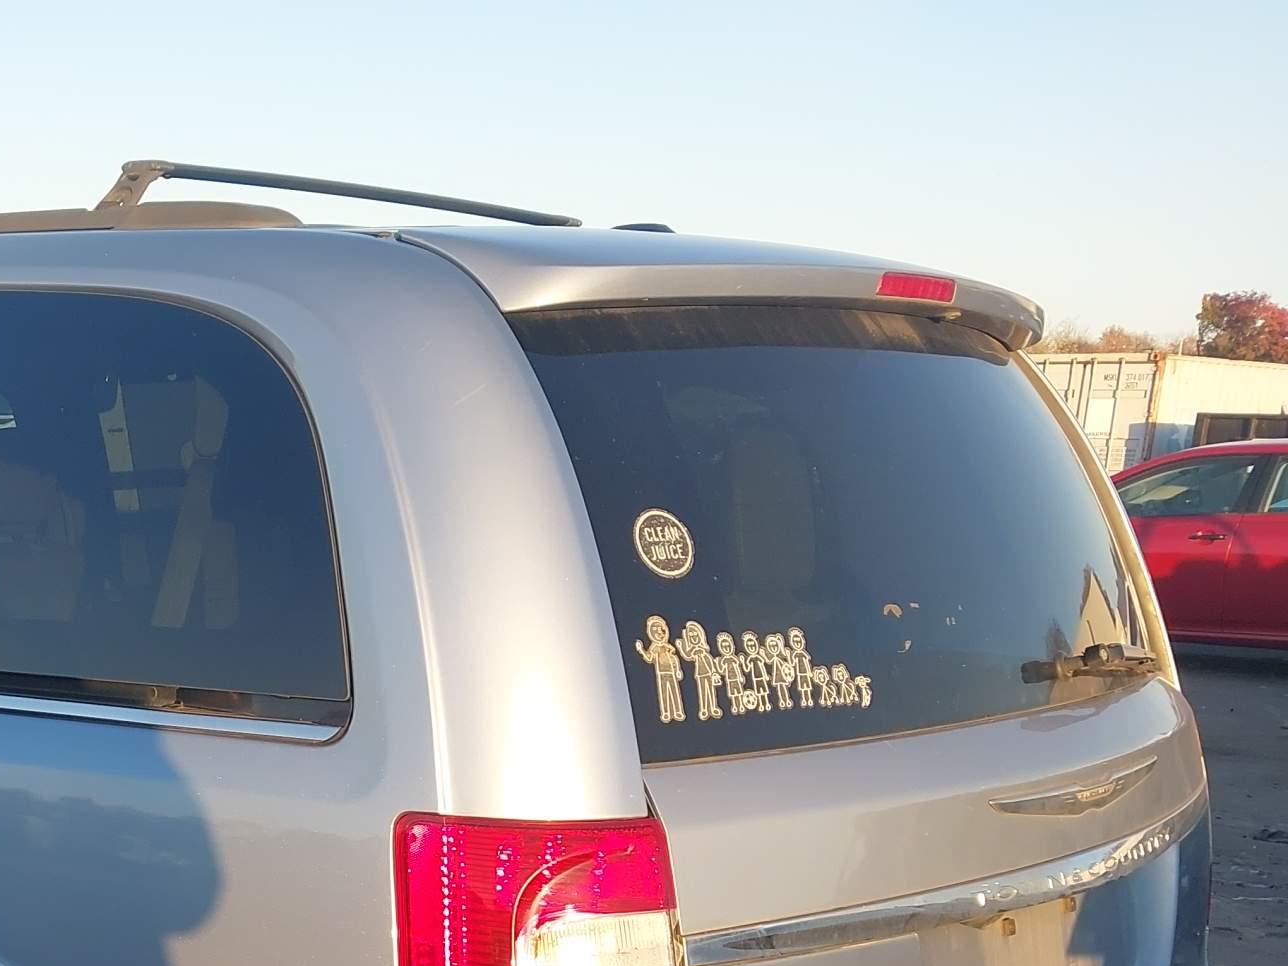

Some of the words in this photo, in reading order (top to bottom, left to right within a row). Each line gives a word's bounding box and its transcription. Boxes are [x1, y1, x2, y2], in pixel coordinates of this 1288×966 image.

[644, 523, 683, 542] CLEAN
[650, 543, 687, 561] JUICE
[972, 871, 1066, 907] TON
